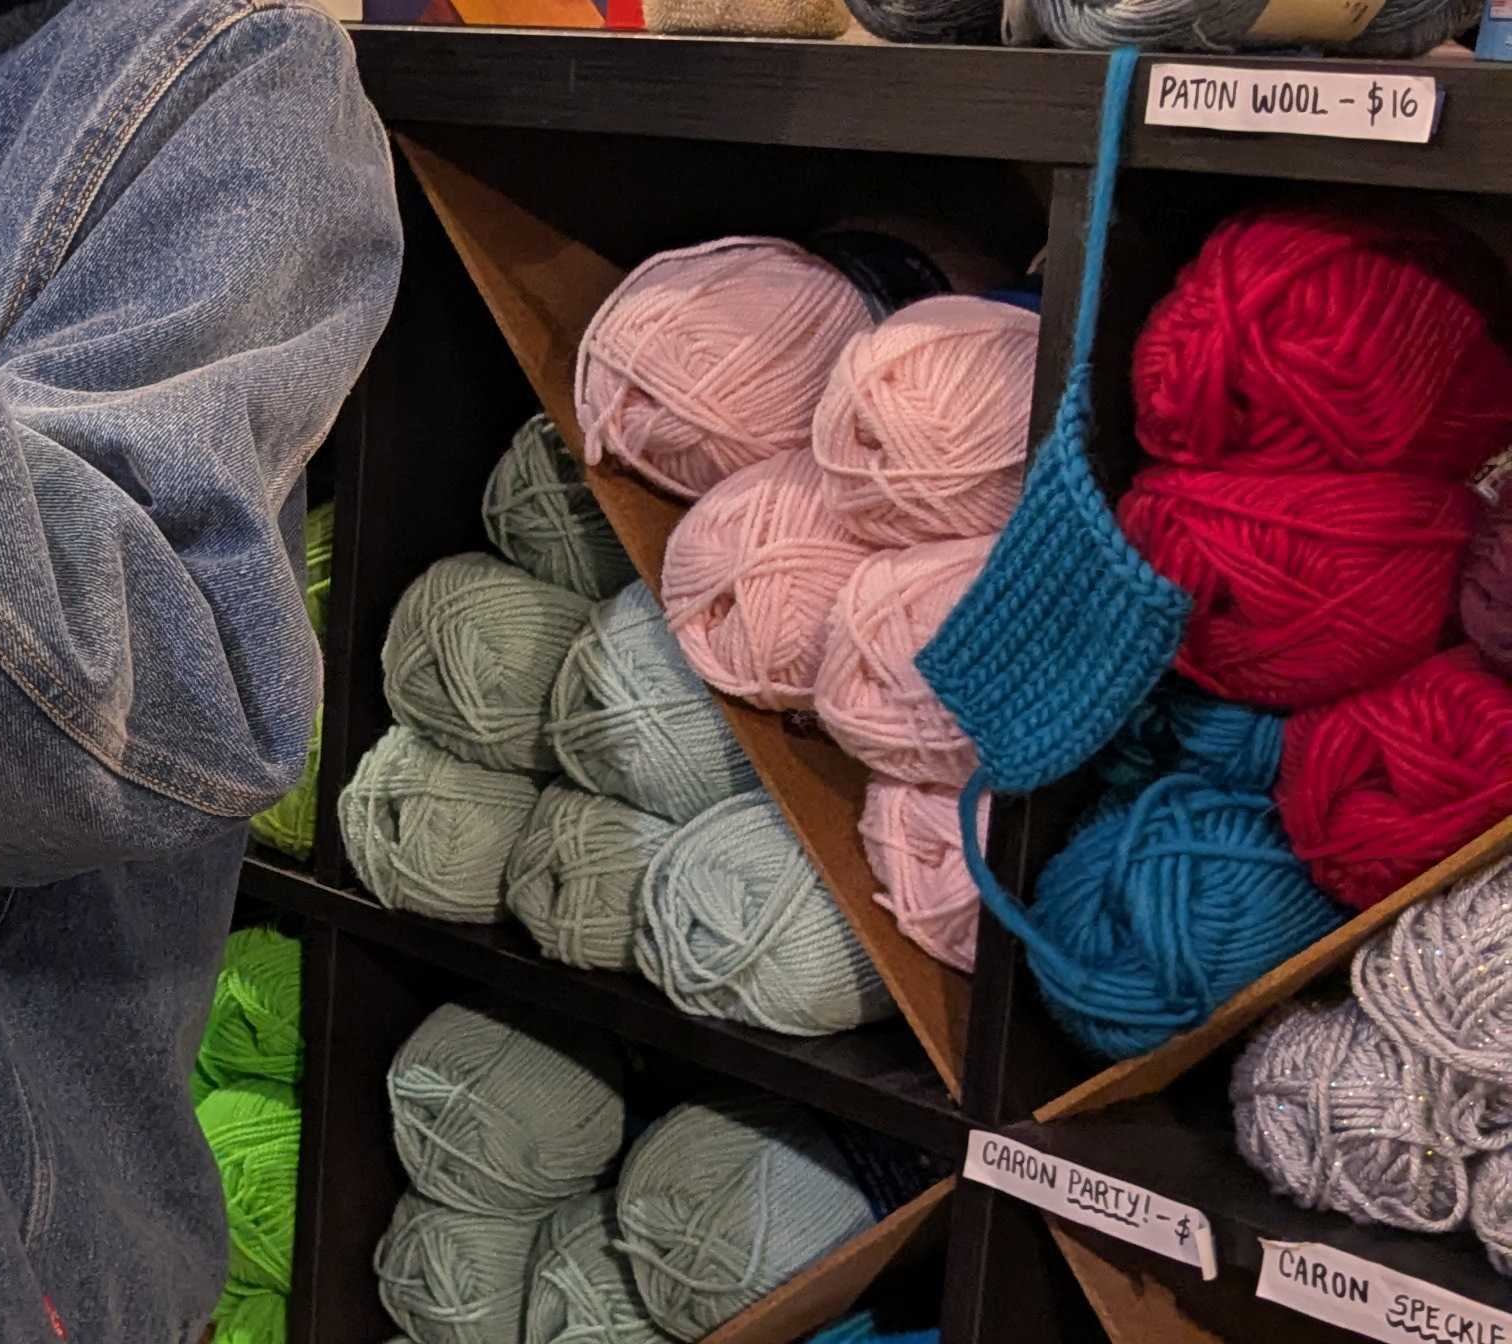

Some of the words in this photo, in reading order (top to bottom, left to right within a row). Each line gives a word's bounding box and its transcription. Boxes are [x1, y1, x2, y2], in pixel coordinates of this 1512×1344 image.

[1159, 75, 1239, 112] PATON
[1252, 82, 1328, 115] WOOL
[1367, 81, 1418, 126] $16
[982, 1140, 1057, 1188] CARON
[1068, 1169, 1151, 1223] PARTY!
[1279, 1249, 1369, 1303] CARON
